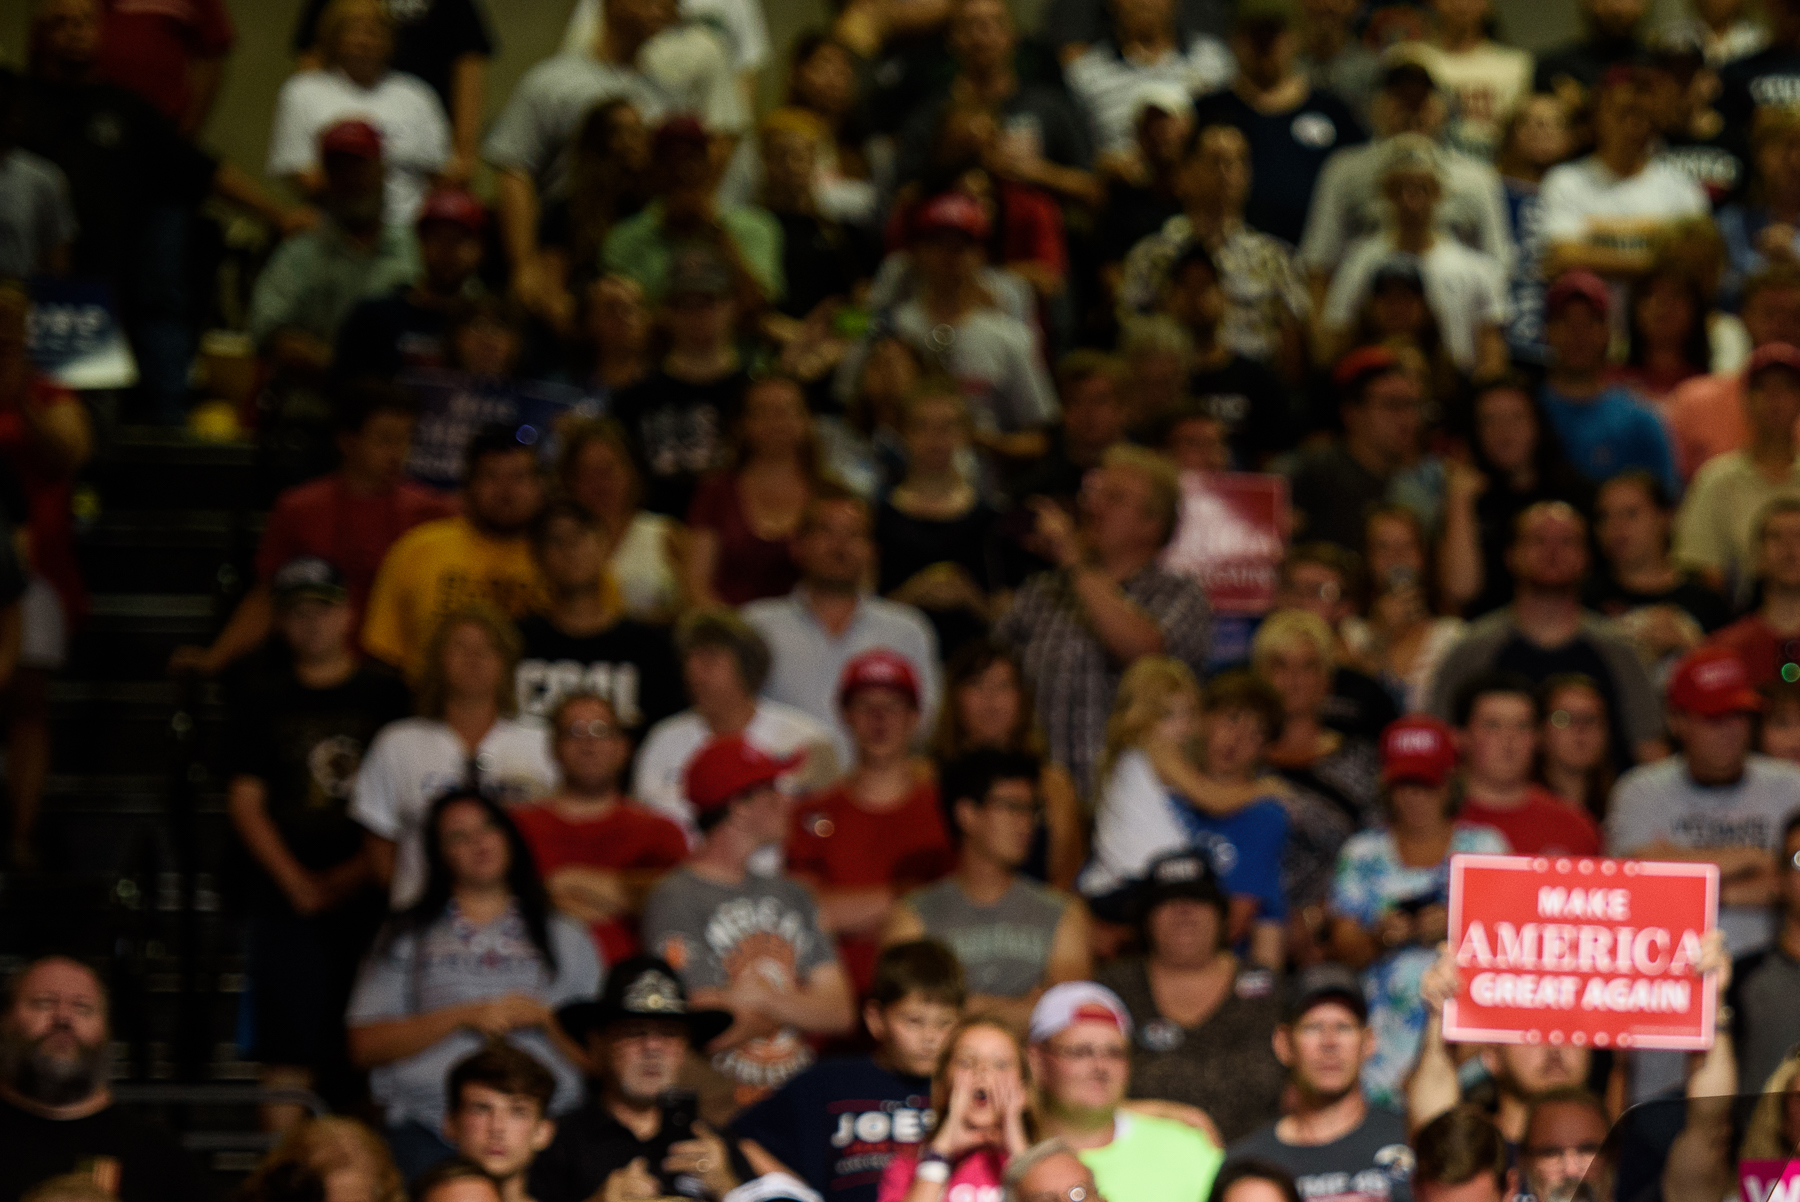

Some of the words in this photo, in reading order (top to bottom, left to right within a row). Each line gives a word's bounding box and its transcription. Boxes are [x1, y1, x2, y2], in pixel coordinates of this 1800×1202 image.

[1537, 885, 1632, 922] MAKE
[1456, 919, 1704, 977] AMERICA
[1470, 972, 1583, 1012] GREAT
[1581, 976, 1692, 1015] AGAIN
